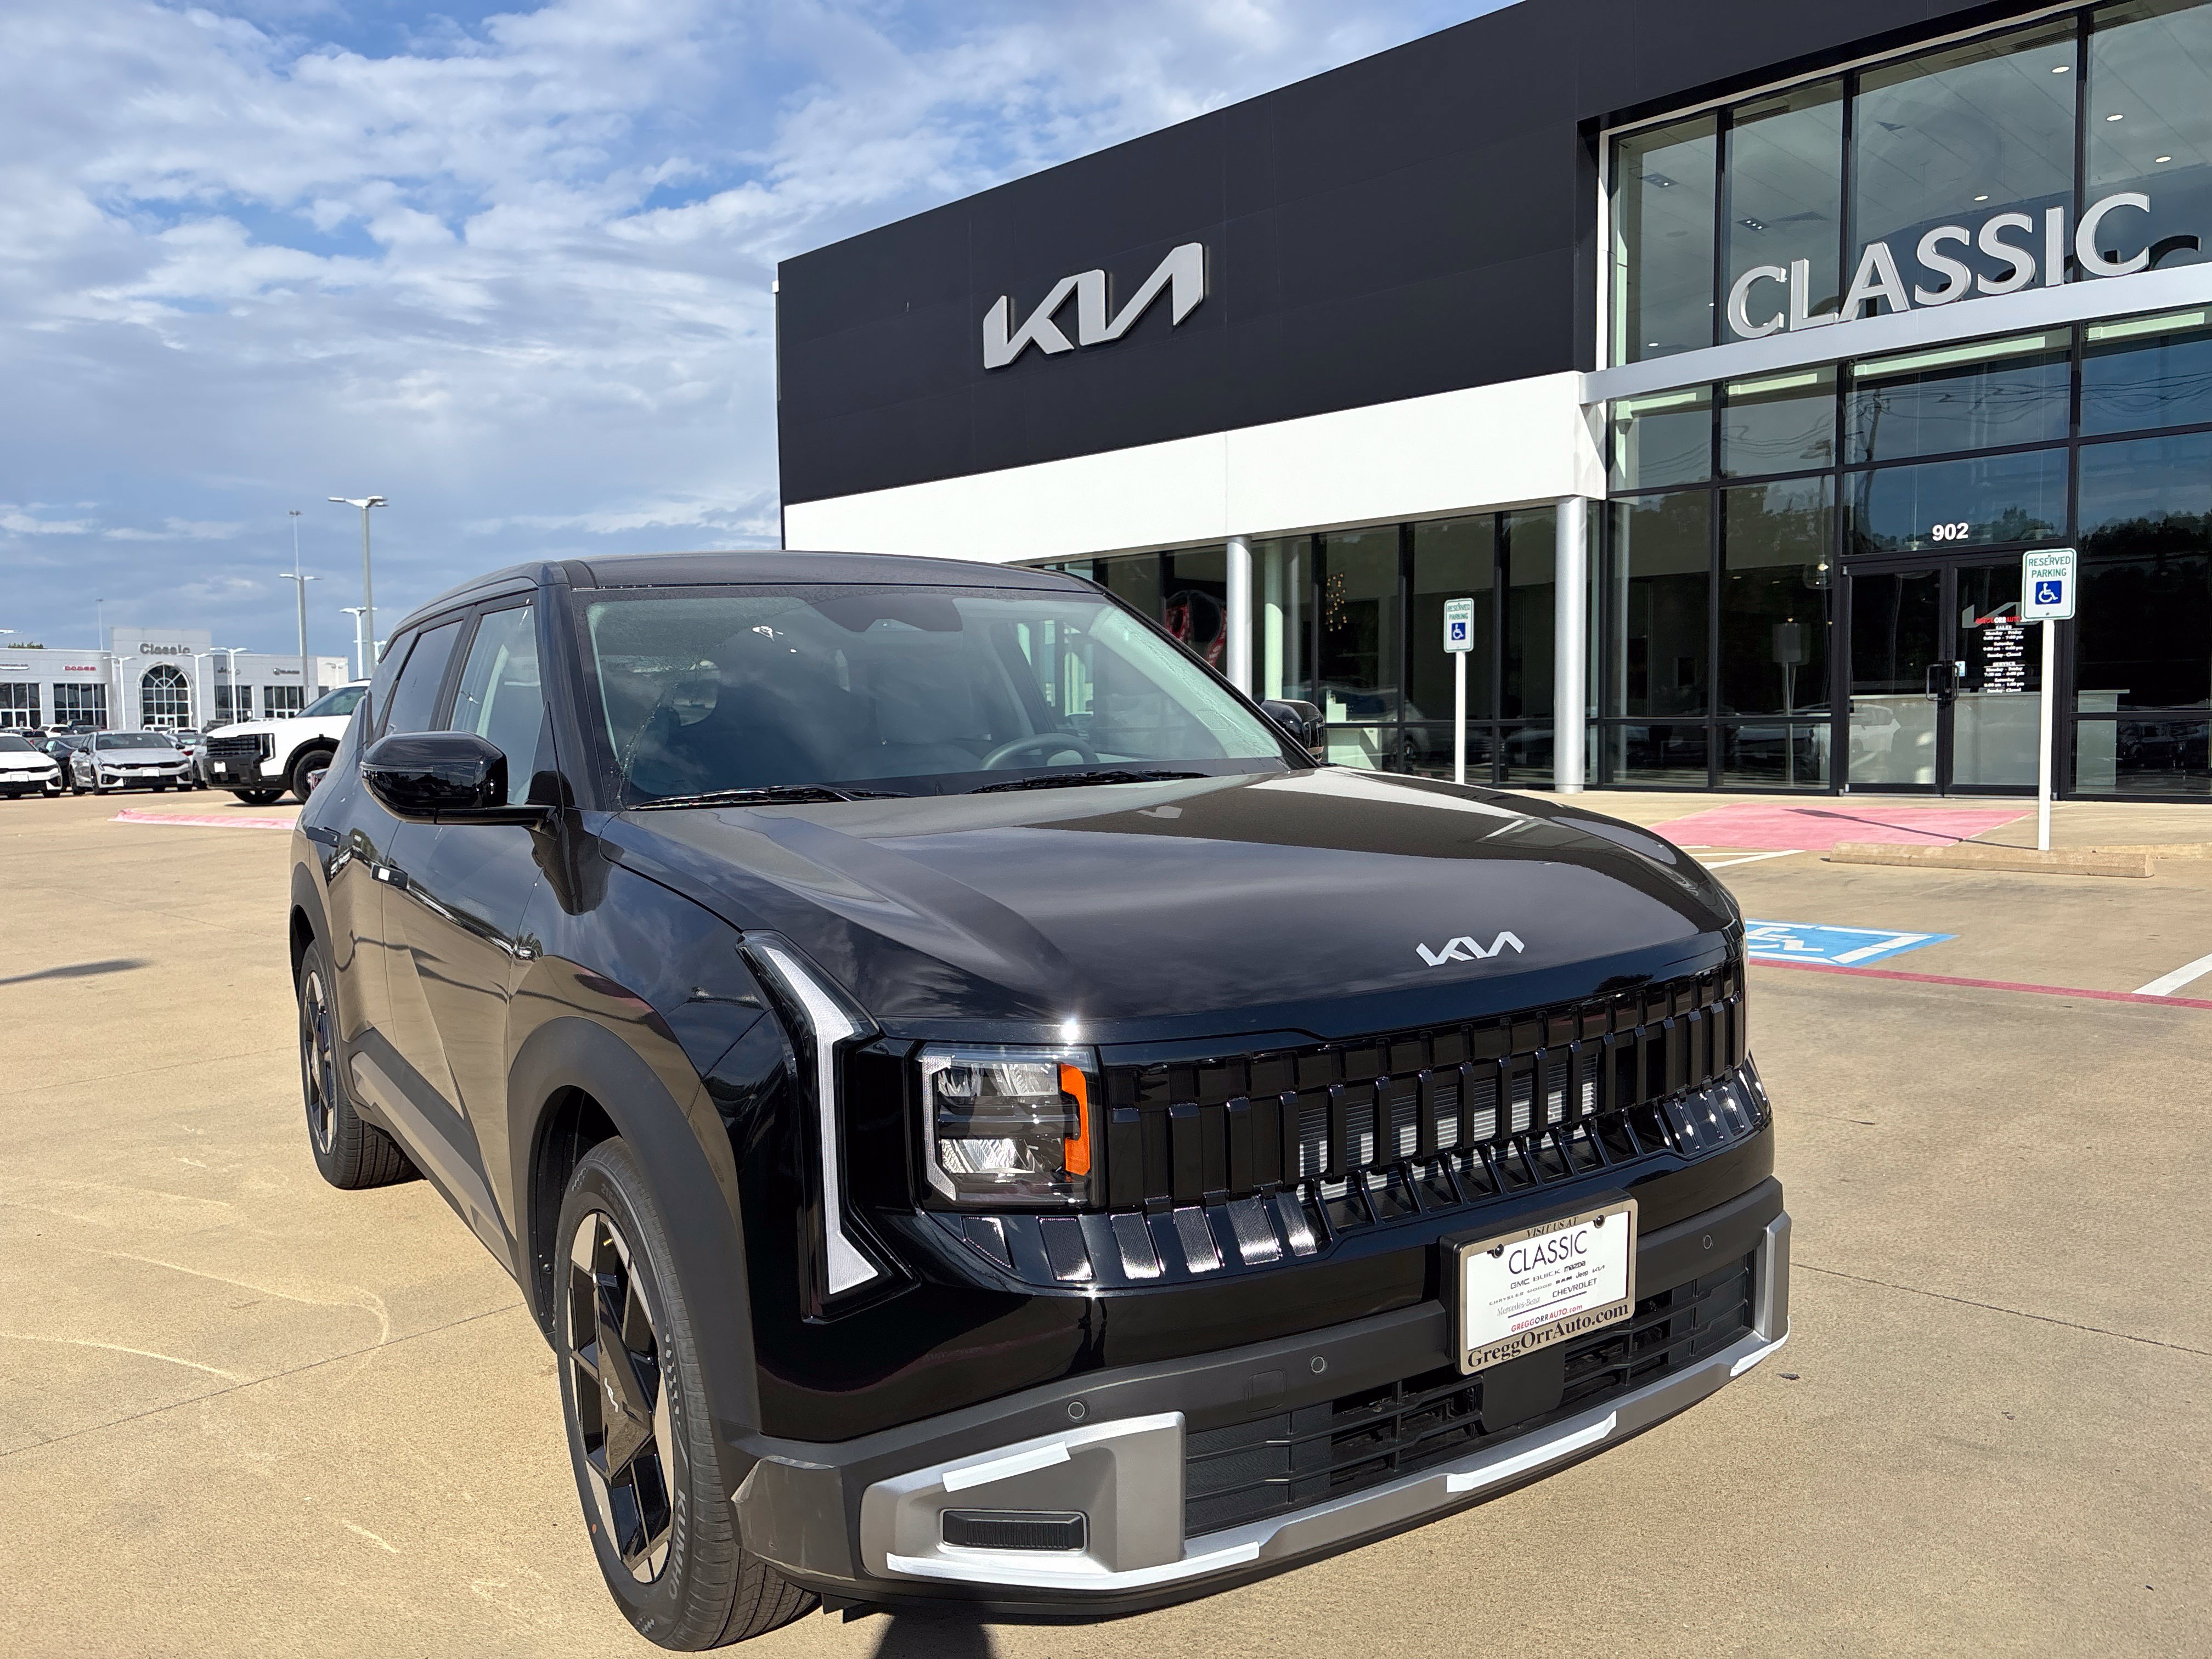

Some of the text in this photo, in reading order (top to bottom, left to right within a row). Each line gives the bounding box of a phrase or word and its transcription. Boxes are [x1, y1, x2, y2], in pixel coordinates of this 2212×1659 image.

[1728, 191, 2150, 339] CLASSIC
[983, 242, 1204, 369] KIA
[1932, 522, 1968, 541] 902
[2028, 556, 2070, 567] RESERVED
[2032, 568, 2067, 578] PARKING
[1415, 931, 1525, 967] KIA
[1527, 1216, 1578, 1238] VISIT US AT
[1509, 1230, 1587, 1274] CLASSIC
[1489, 1291, 1524, 1305] CHRYSLER
[1555, 1276, 1572, 1284] RAM
[1576, 1269, 1589, 1278] Jeep
[1497, 1277, 1598, 1316] Mercedes-Benz CHEVROLET
[1510, 1278, 1530, 1289] GMC
[1533, 1269, 1561, 1282] BUICK
[1468, 1304, 1629, 1367] GreggOrrAuto.com
[1511, 1305, 1583, 1333] GREGGORRAUTO.com
[669, 1488, 686, 1600] KUMHO
